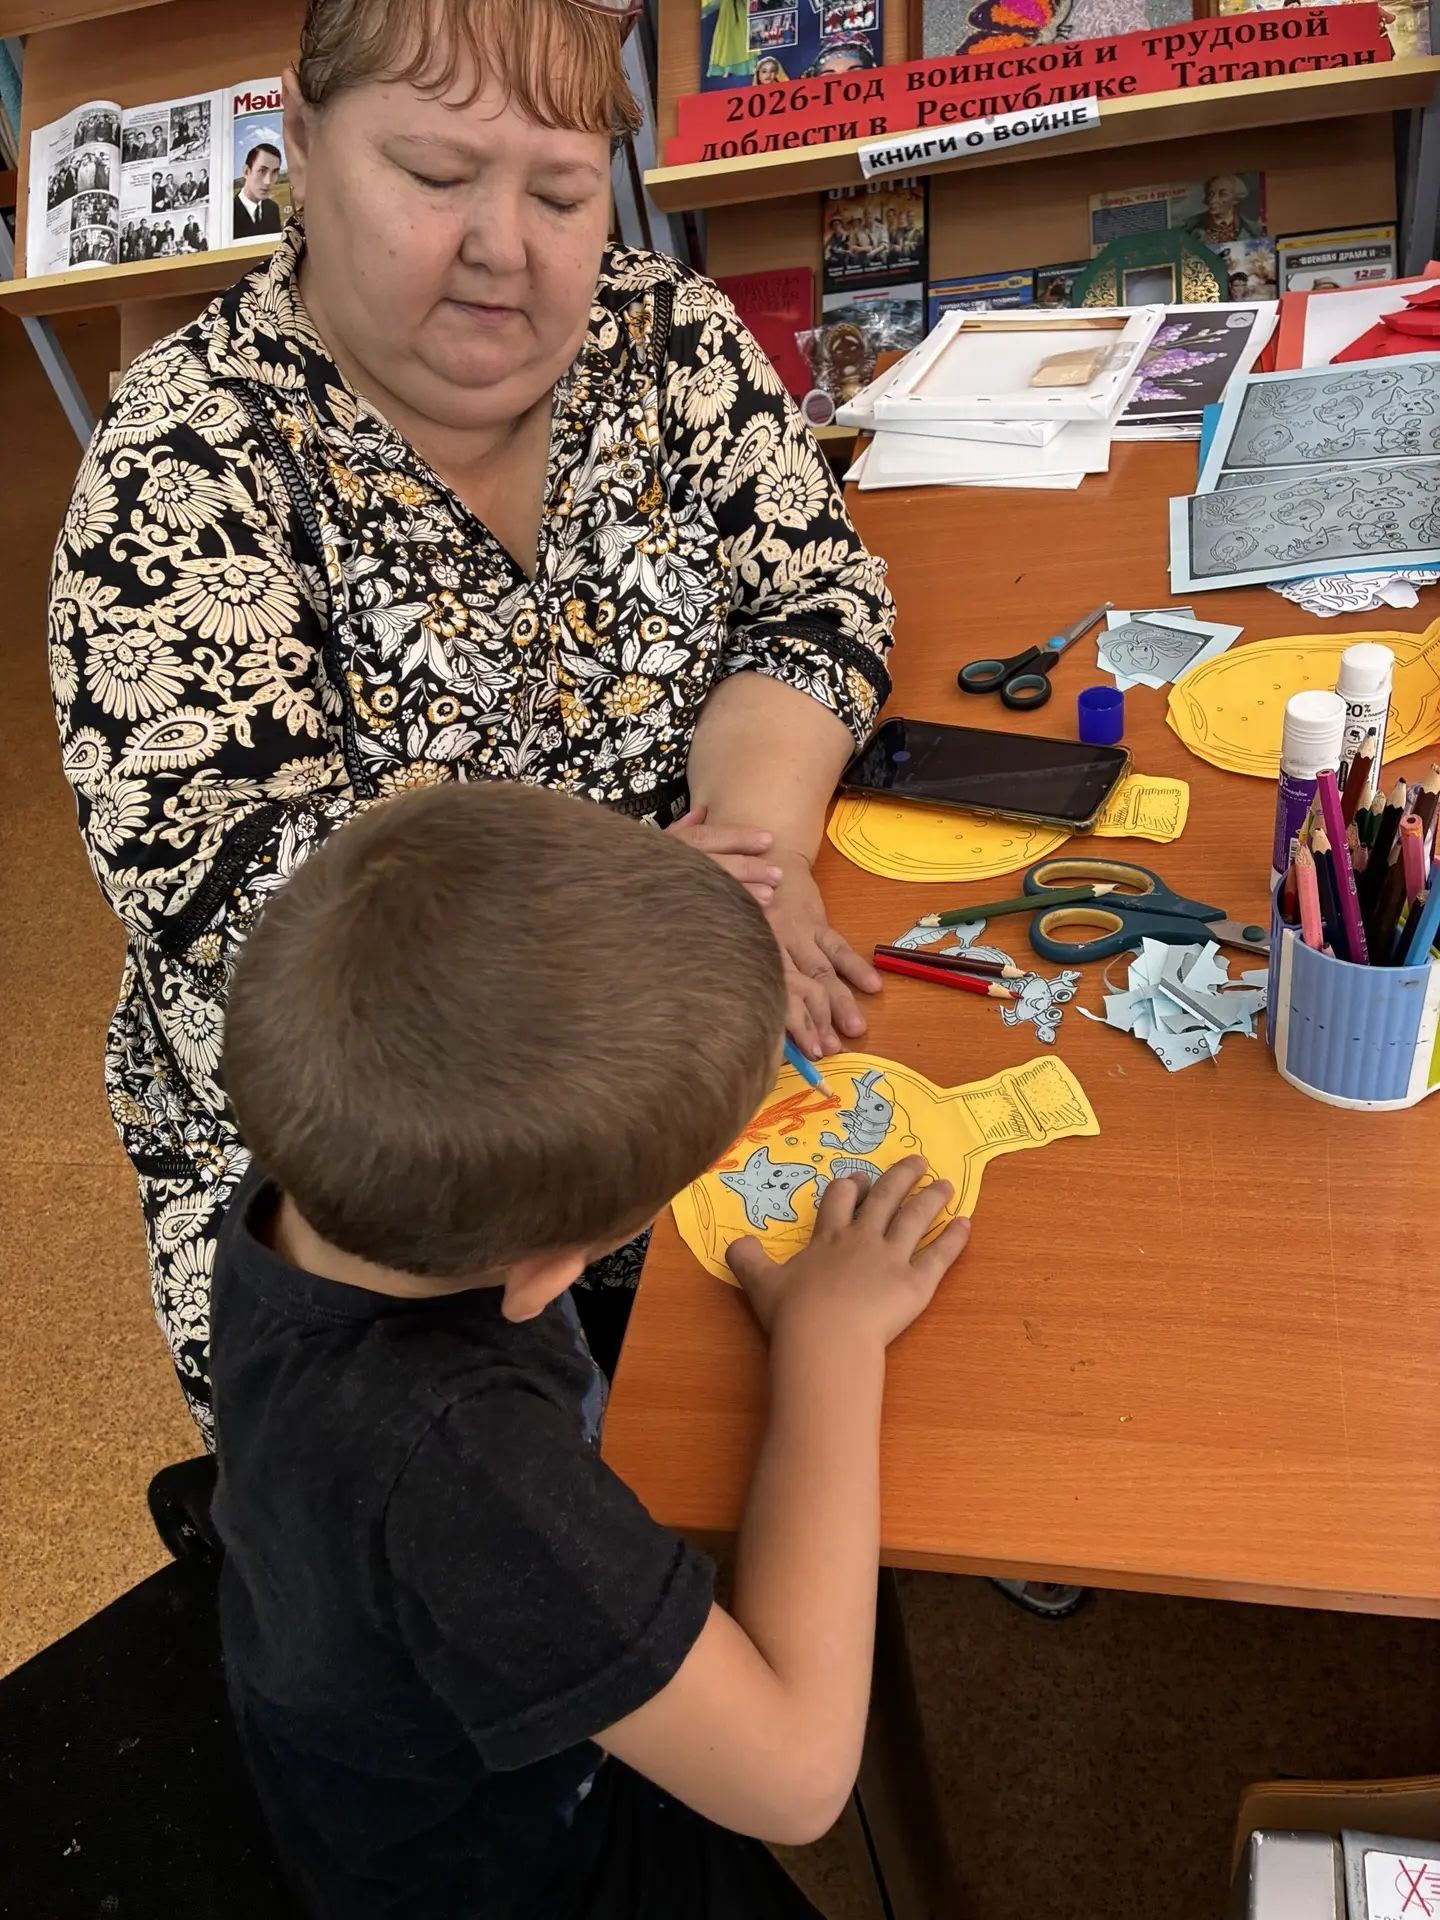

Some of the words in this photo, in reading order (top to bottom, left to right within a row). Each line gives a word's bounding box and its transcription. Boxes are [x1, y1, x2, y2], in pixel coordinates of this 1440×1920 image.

[699, 121, 859, 162] доблести
[868, 116, 888, 136] в
[916, 74, 1137, 128] Республике
[1170, 50, 1376, 88] Татарстан
[726, 78, 885, 122] 2026-Год
[907, 44, 1083, 92] воинской
[1095, 45, 1118, 64] и
[1141, 10, 1330, 60] трудовой
[868, 136, 958, 169] КНИГИ
[965, 131, 985, 147] О
[993, 107, 1089, 141] ВОЙНЕ
